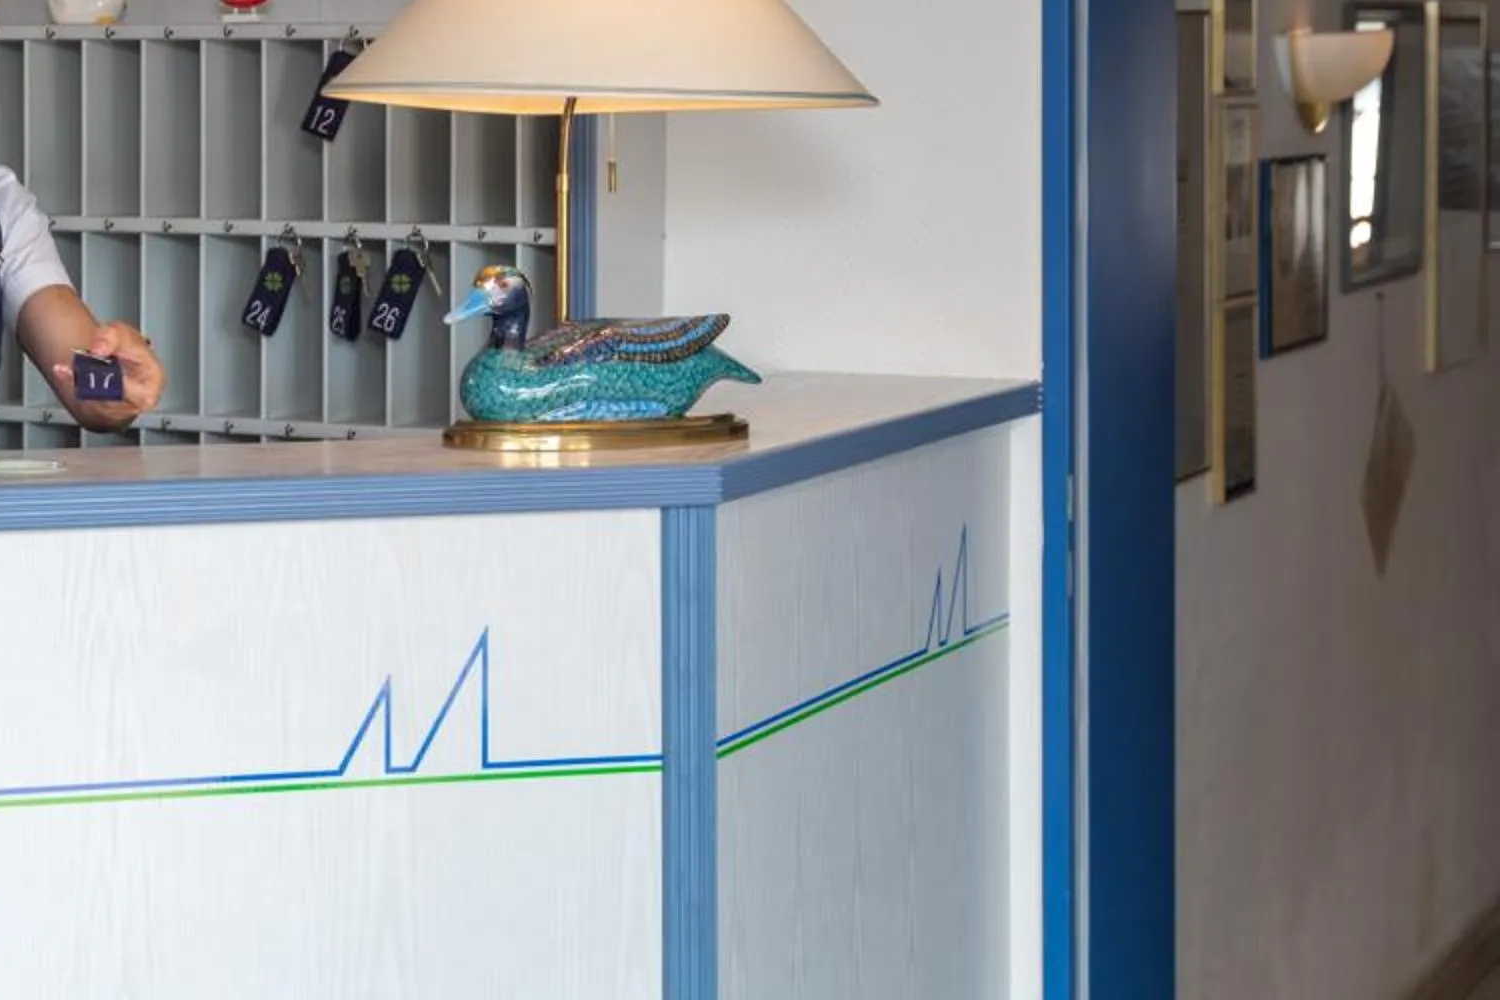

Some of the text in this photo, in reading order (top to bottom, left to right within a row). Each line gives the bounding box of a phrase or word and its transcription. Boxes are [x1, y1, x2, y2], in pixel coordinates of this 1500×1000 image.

[309, 105, 336, 135] 12
[244, 299, 272, 331] 24
[371, 302, 401, 332] 26
